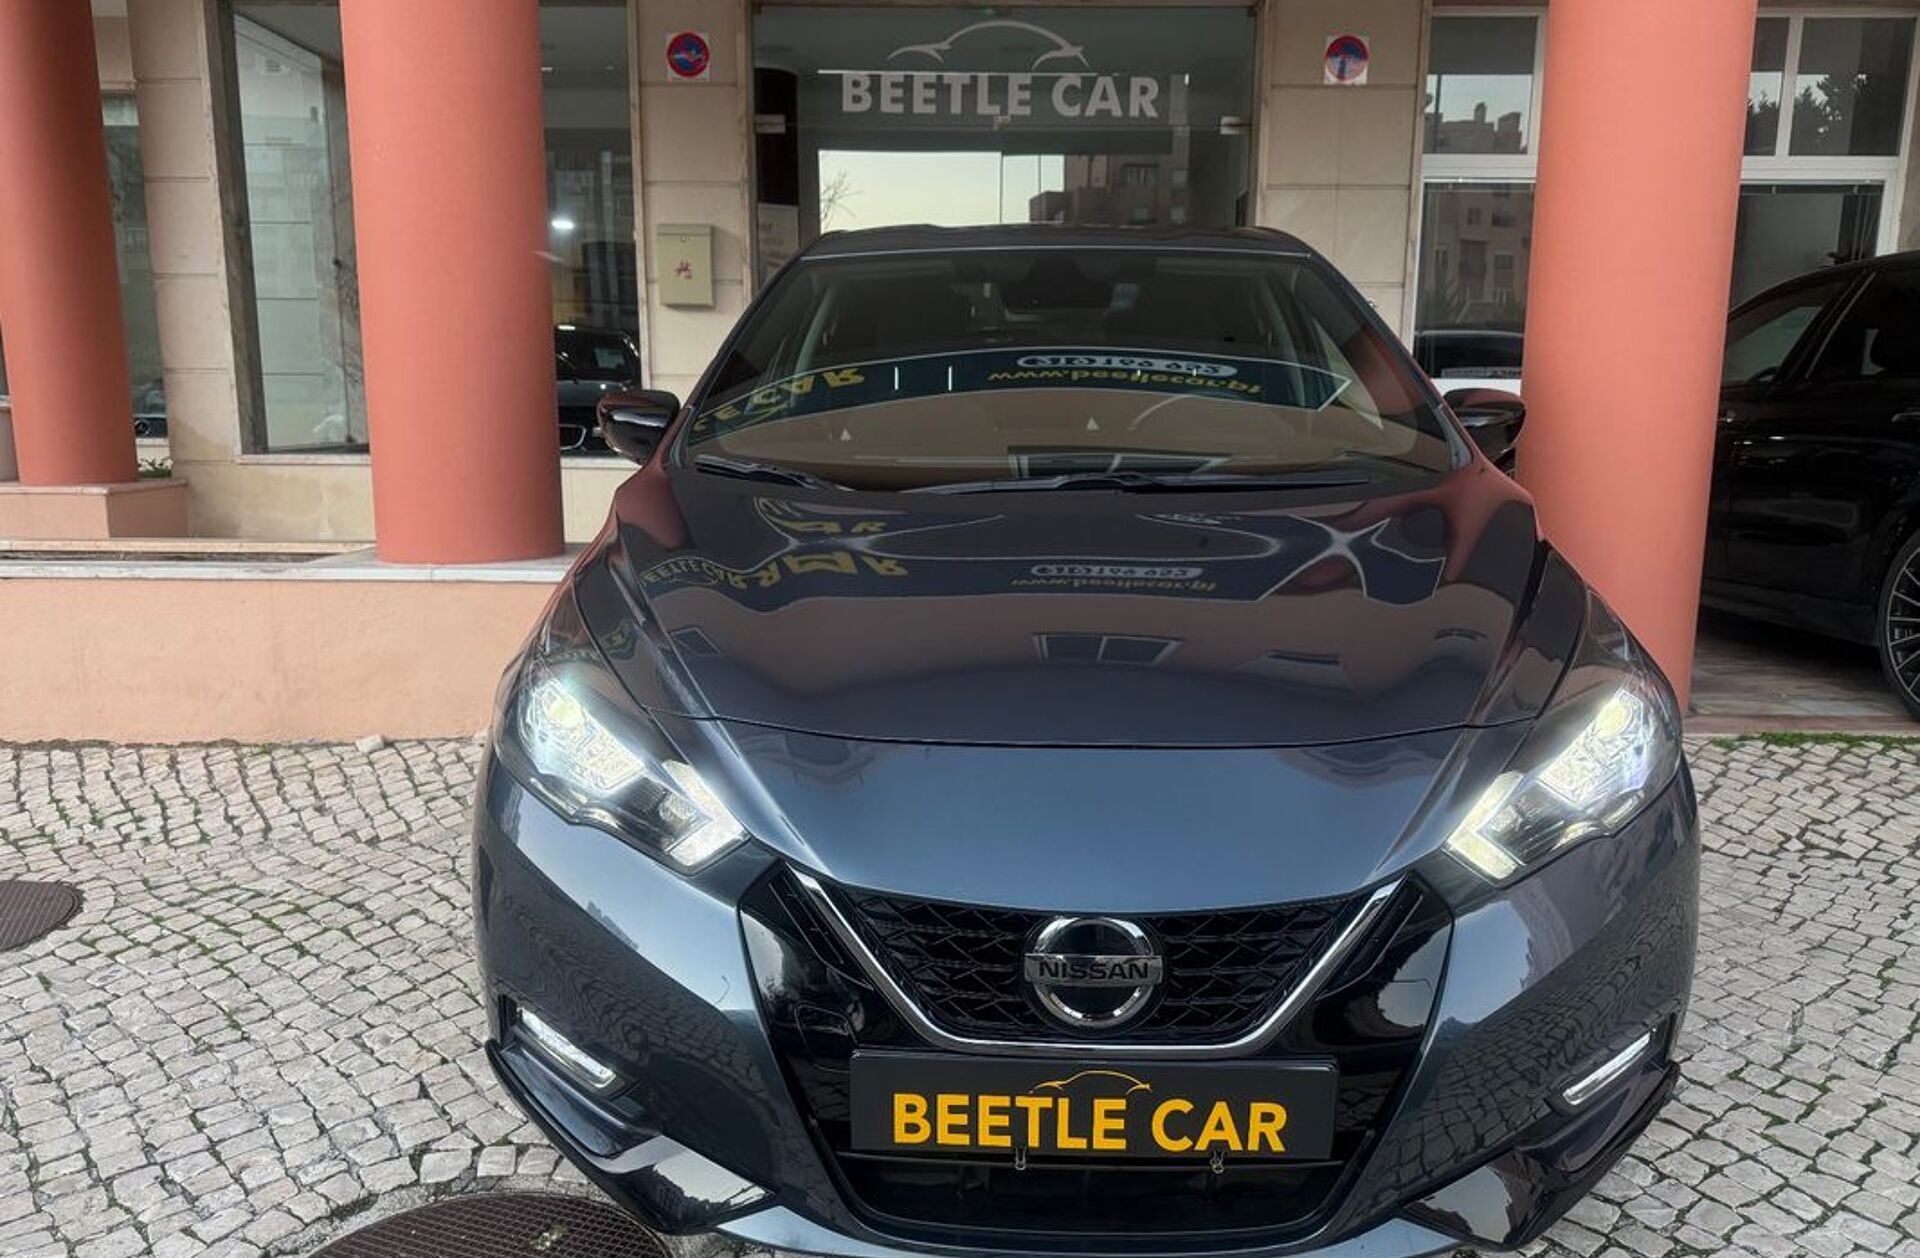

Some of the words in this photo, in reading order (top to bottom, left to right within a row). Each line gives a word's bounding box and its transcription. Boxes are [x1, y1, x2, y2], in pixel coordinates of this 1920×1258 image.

[842, 72, 1032, 116] BEETLE
[1051, 74, 1159, 118] CAR
[1040, 962, 1148, 979] NISSAN
[892, 1093, 1127, 1151] BEETLE
[1151, 1098, 1288, 1153] CAR
